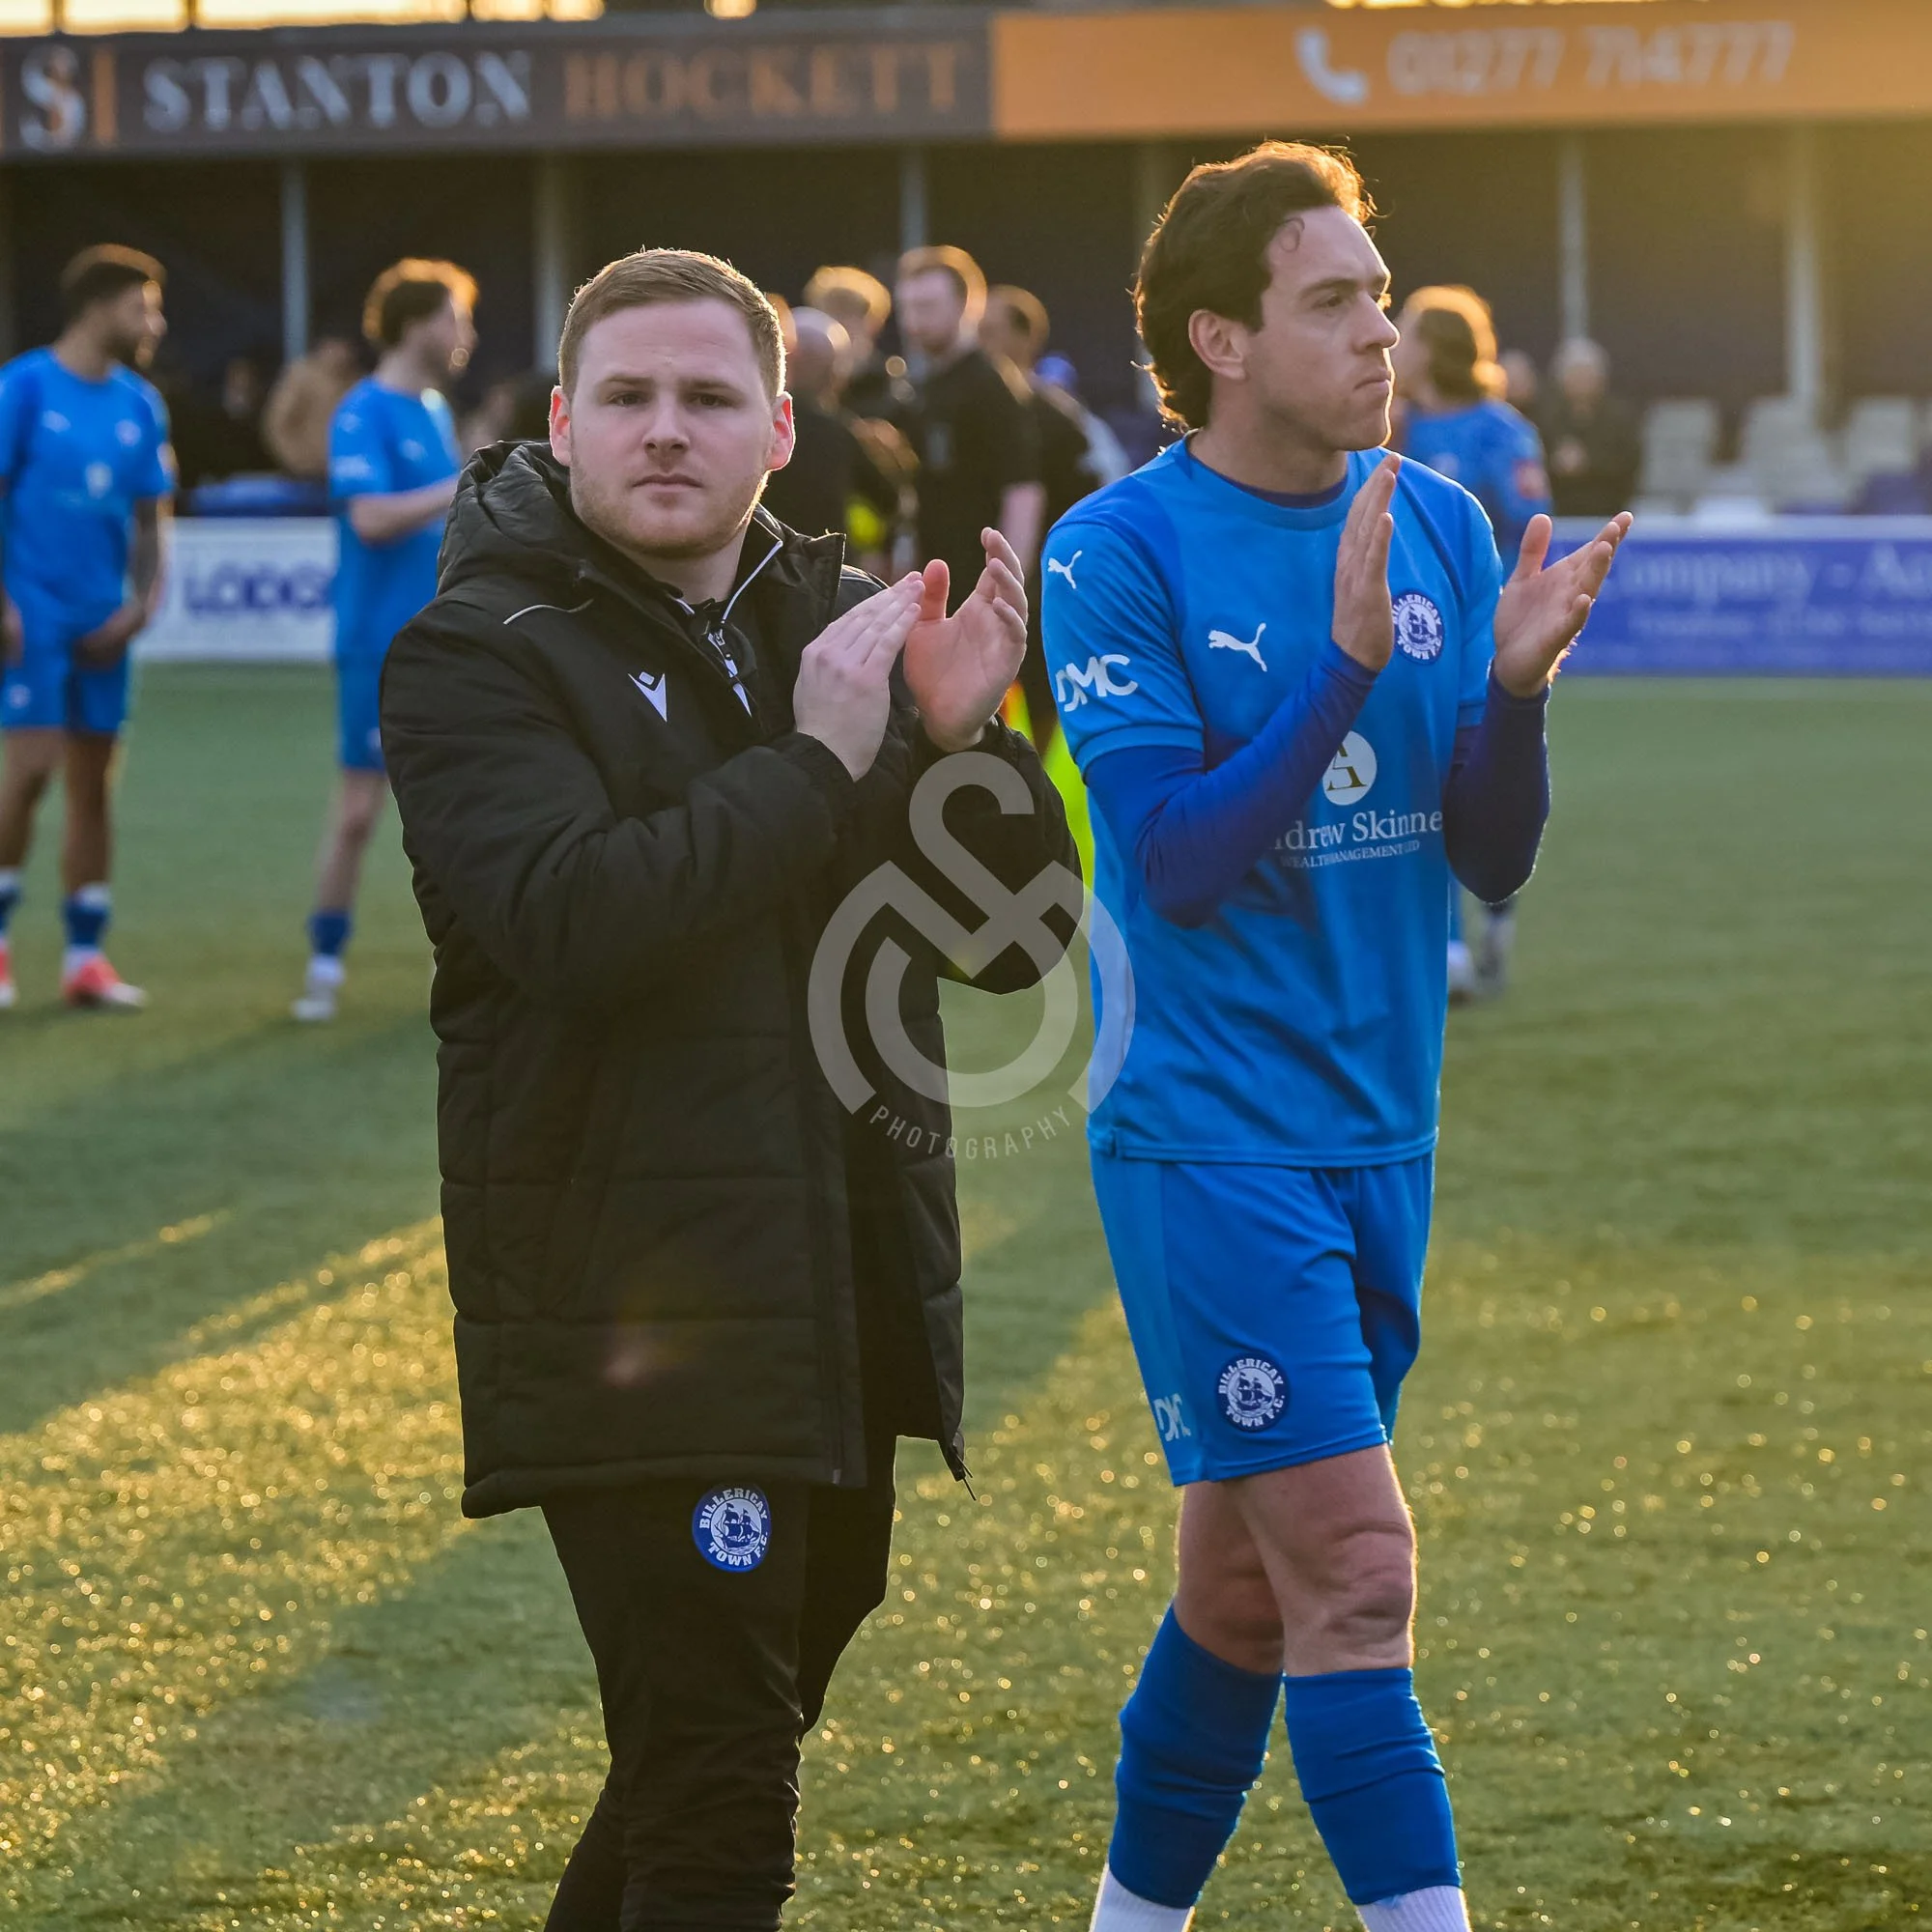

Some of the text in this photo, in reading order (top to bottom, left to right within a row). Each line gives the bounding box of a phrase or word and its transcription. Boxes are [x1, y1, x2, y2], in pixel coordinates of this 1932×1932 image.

[143, 43, 956, 132] STANTON HOCKETT
[1055, 654, 1138, 712] DMC
[1274, 820, 1346, 851] drew
[1218, 1358, 1284, 1394] BILLERICAY
[1226, 1406, 1264, 1427] TOWN
[699, 1488, 768, 1529] BILLERICAY
[708, 1541, 753, 1567] TOWN
